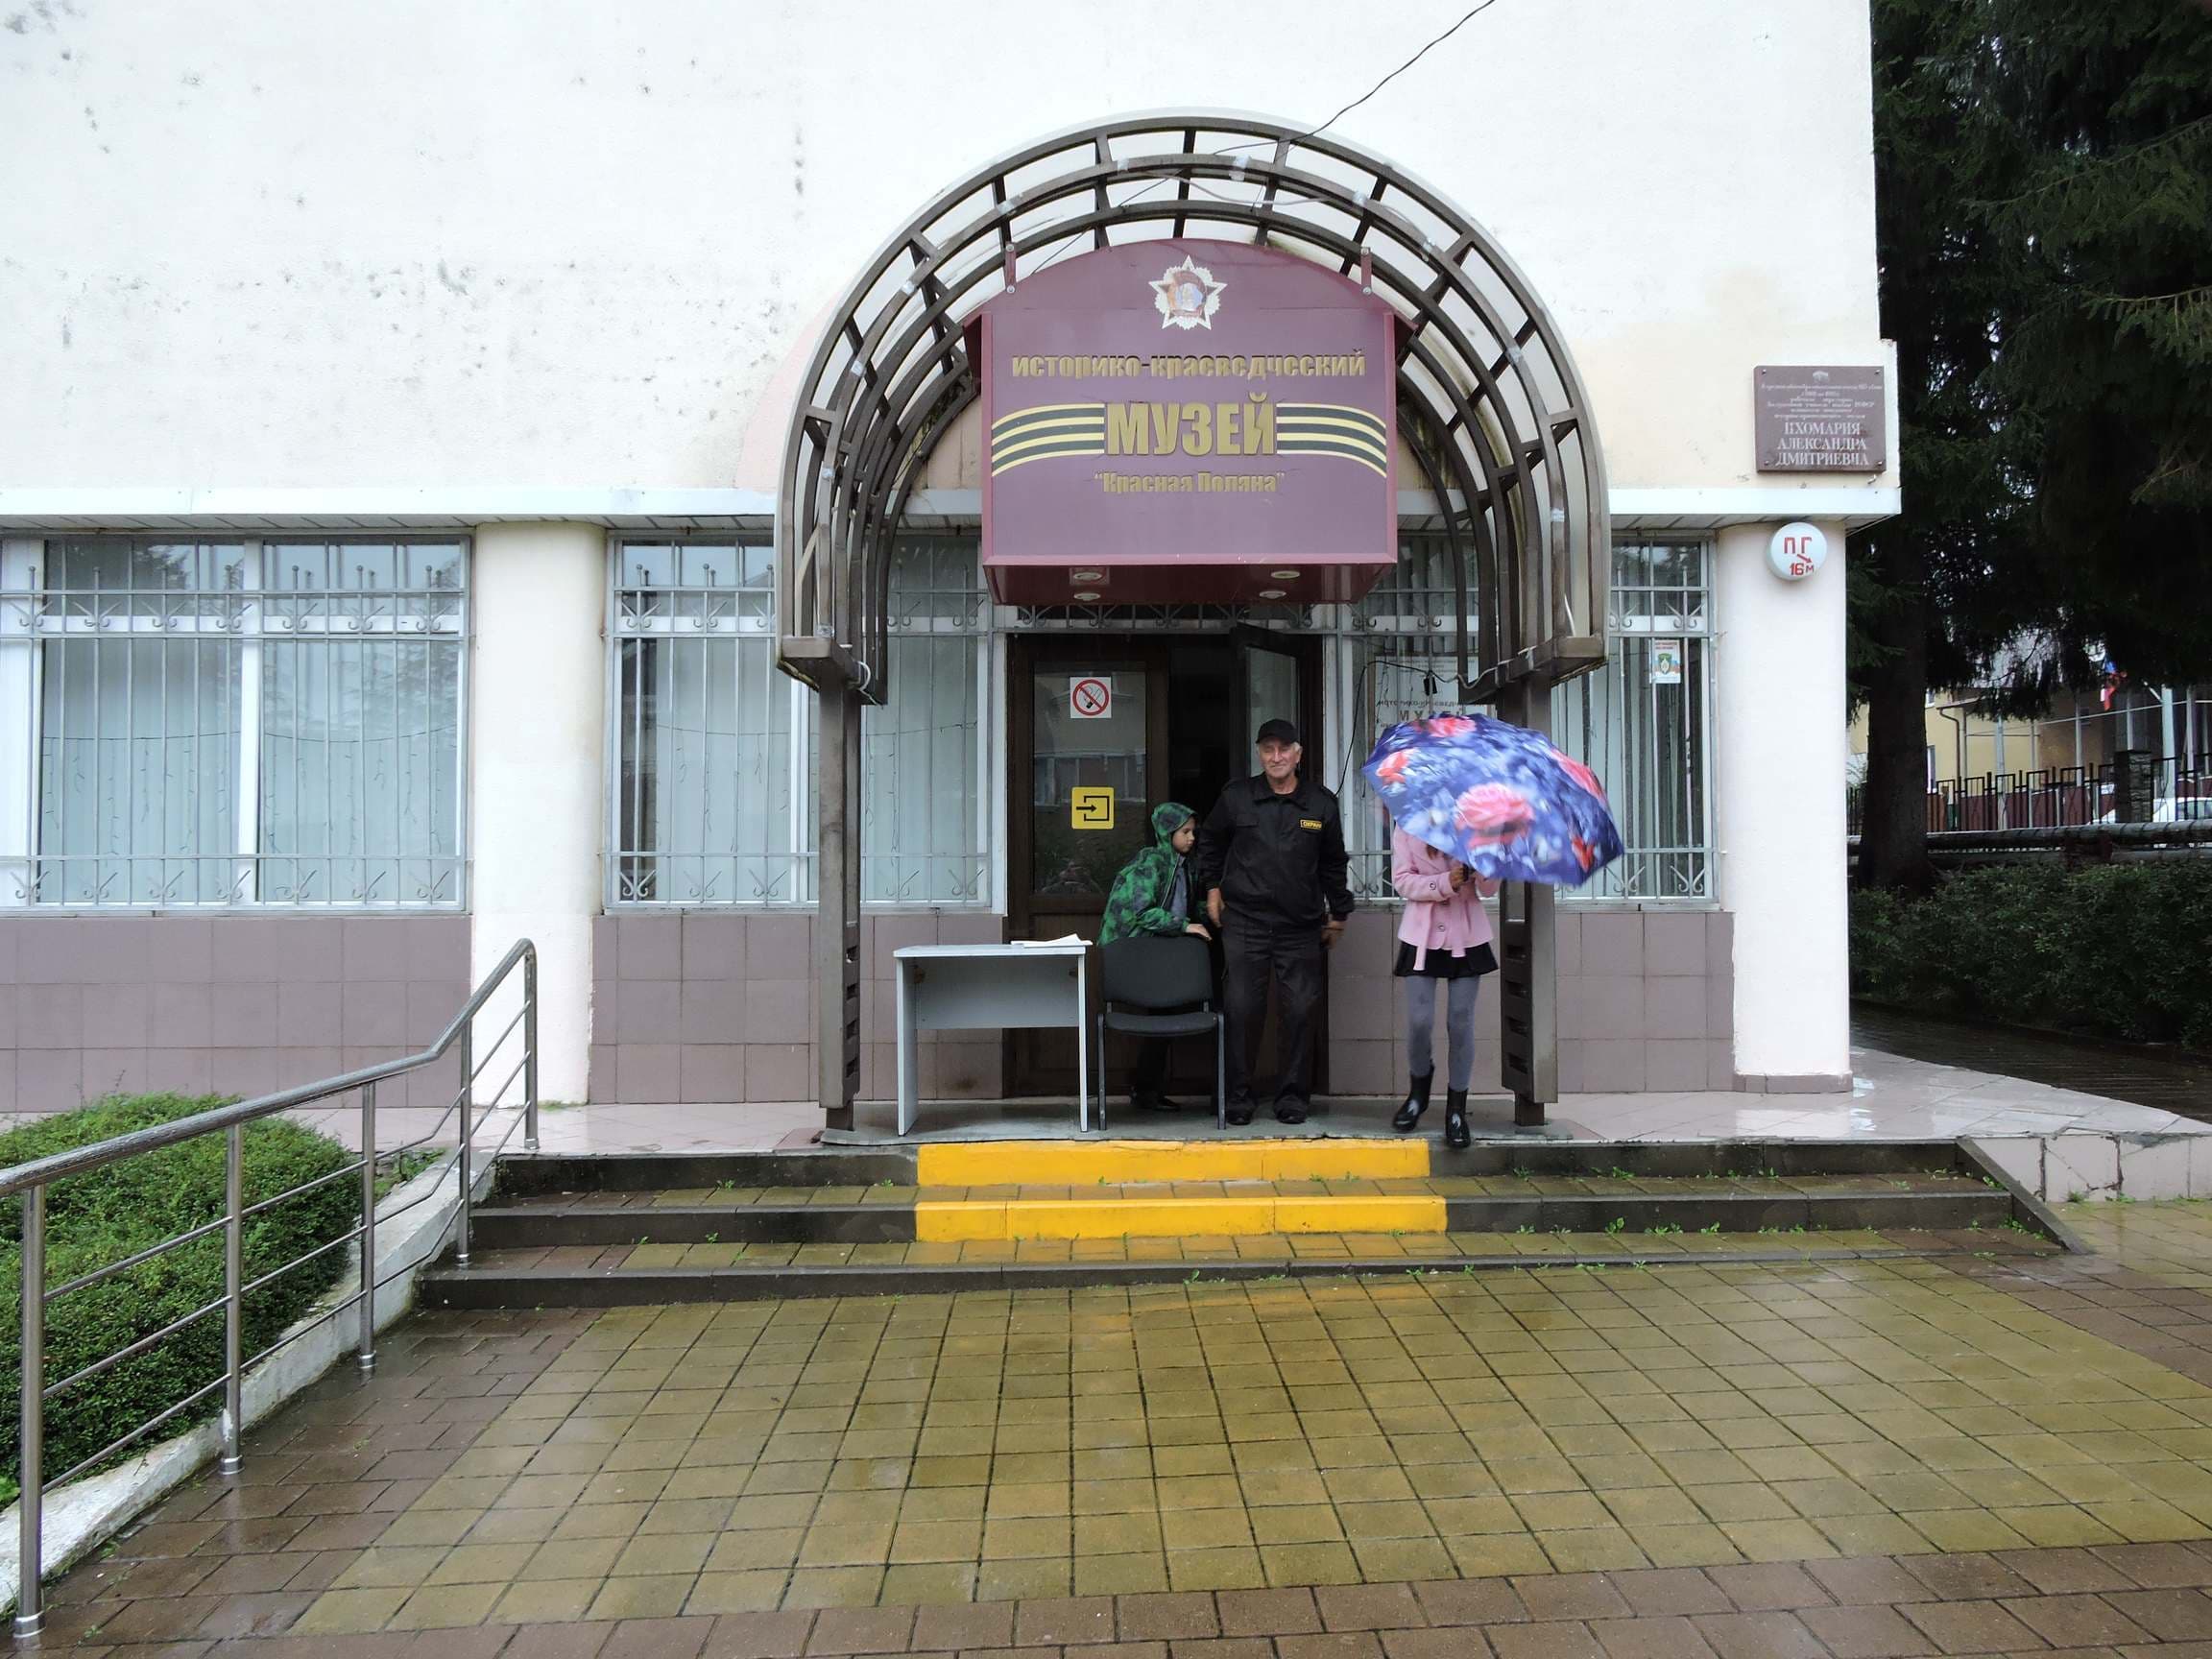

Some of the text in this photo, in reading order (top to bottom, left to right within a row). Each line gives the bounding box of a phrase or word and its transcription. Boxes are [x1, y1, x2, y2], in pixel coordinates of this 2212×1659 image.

[1106, 391, 1275, 456] МУЗЕЙ
[1776, 437, 1867, 451] АЛЕКСАНДРА
[1775, 452, 1869, 466] ДМИТРИЕВНА
[1784, 536, 1813, 554] ПГ
